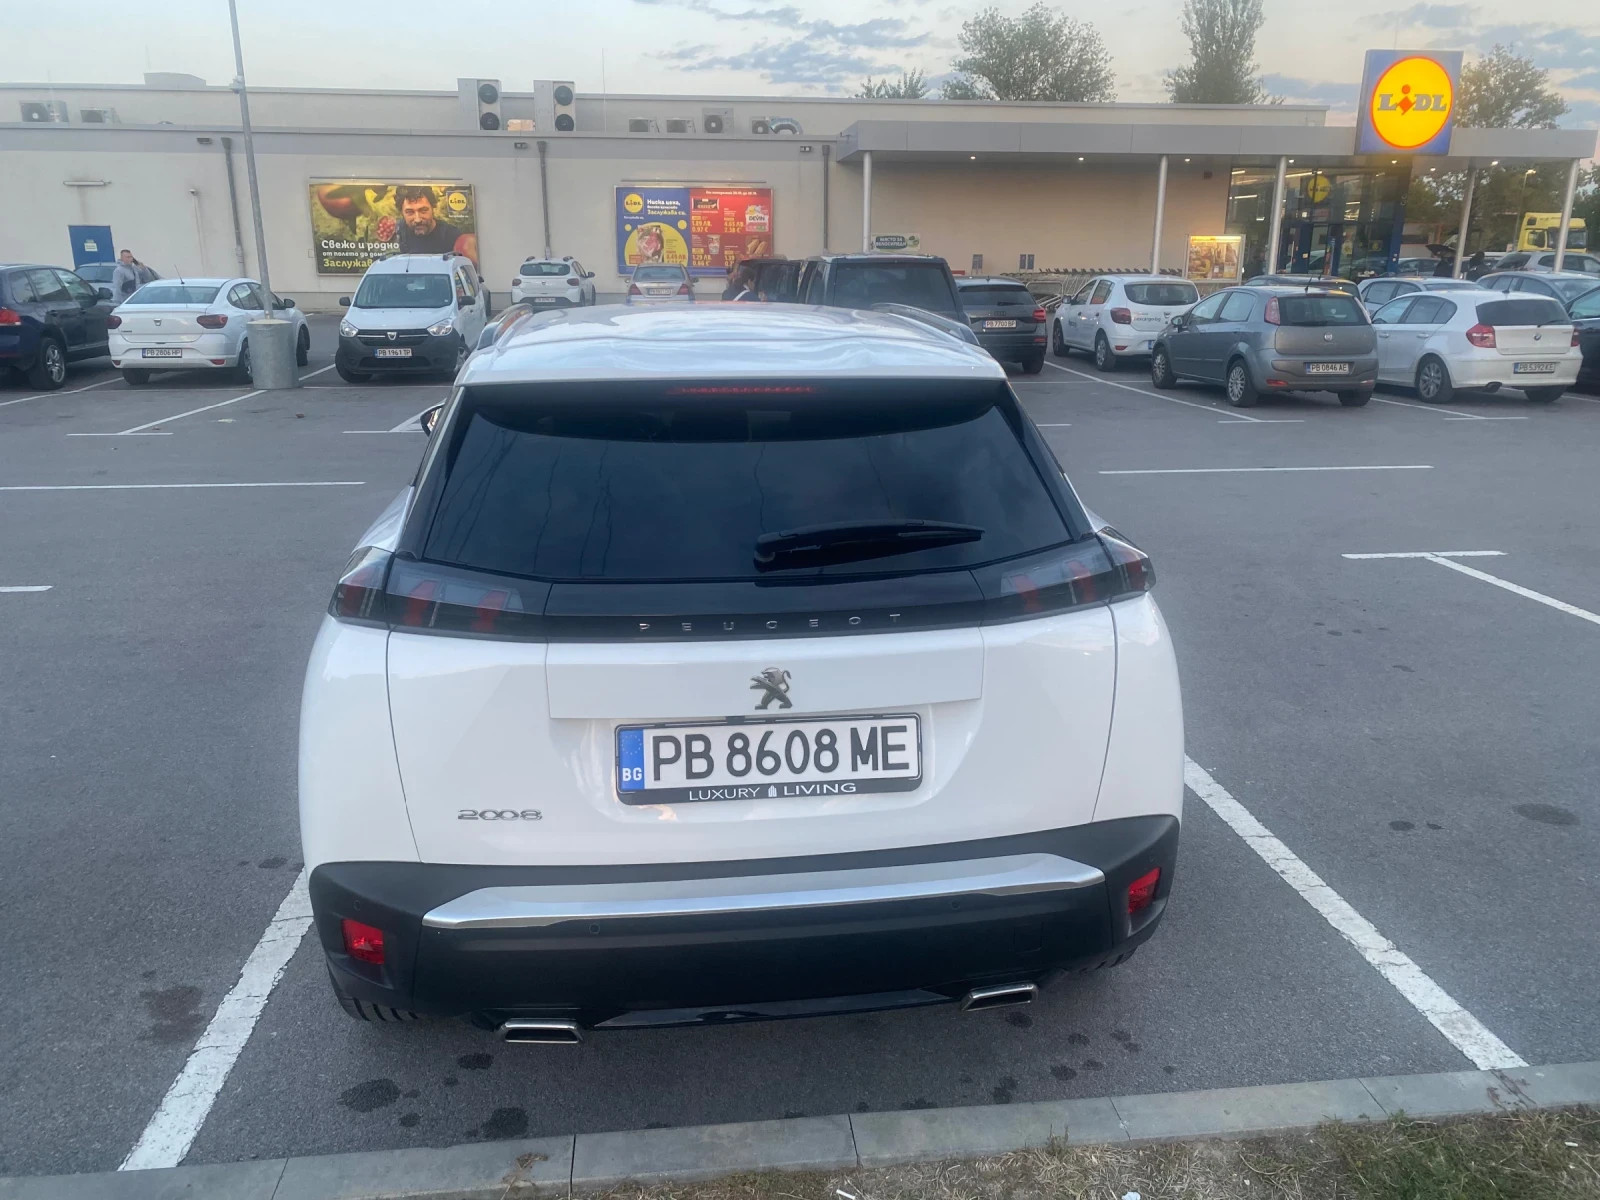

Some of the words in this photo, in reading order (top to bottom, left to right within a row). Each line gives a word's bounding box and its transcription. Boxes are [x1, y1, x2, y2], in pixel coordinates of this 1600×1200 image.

[321, 239, 356, 249] Свежо
[367, 242, 400, 251] родно
[323, 258, 373, 269] Заслужав
[1311, 363, 1321, 371] PB
[1338, 363, 1347, 371] AE
[639, 613, 901, 632] PEUGEOT
[652, 733, 715, 782] PB
[725, 728, 840, 778] 8608
[850, 724, 910, 772] ME
[622, 767, 643, 782] BG
[688, 786, 761, 802] LUXURY
[783, 782, 857, 797] LIVING
[457, 808, 543, 821] 2008
